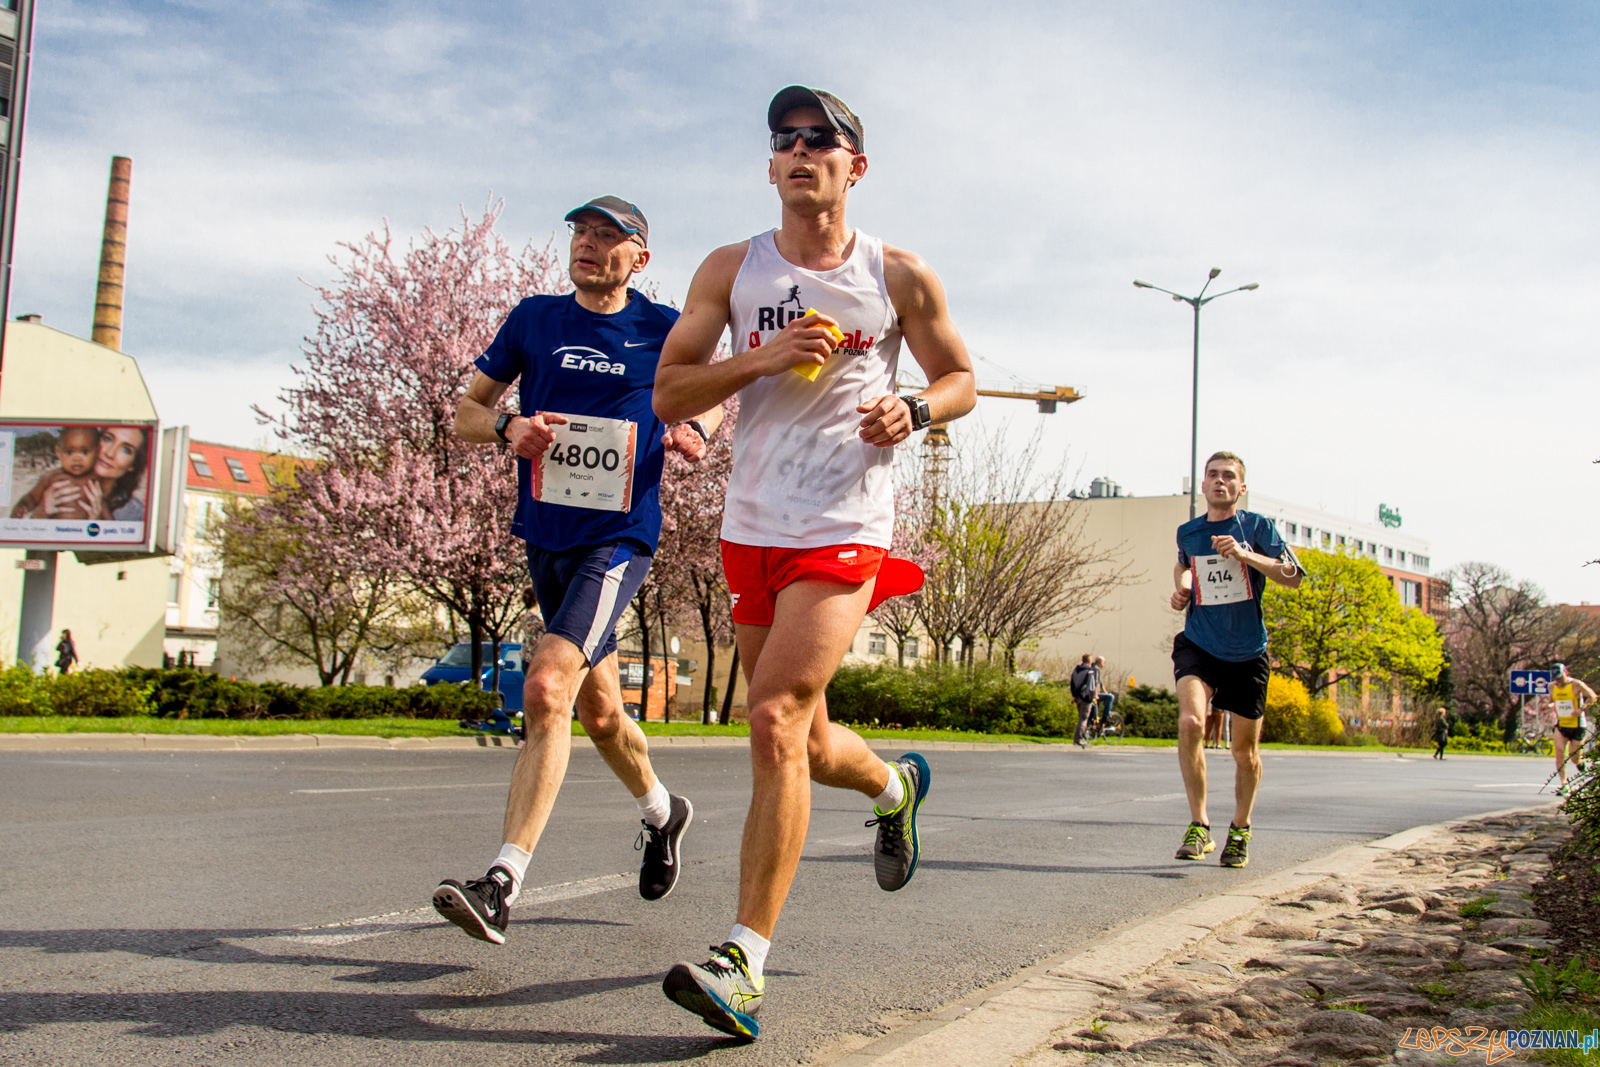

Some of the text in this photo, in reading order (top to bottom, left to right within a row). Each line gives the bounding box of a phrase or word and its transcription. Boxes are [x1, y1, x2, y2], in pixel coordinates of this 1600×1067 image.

[561, 353, 625, 375] Enea
[550, 443, 619, 471] 4800
[569, 472, 593, 481] Marcin
[1207, 570, 1233, 583] 414
